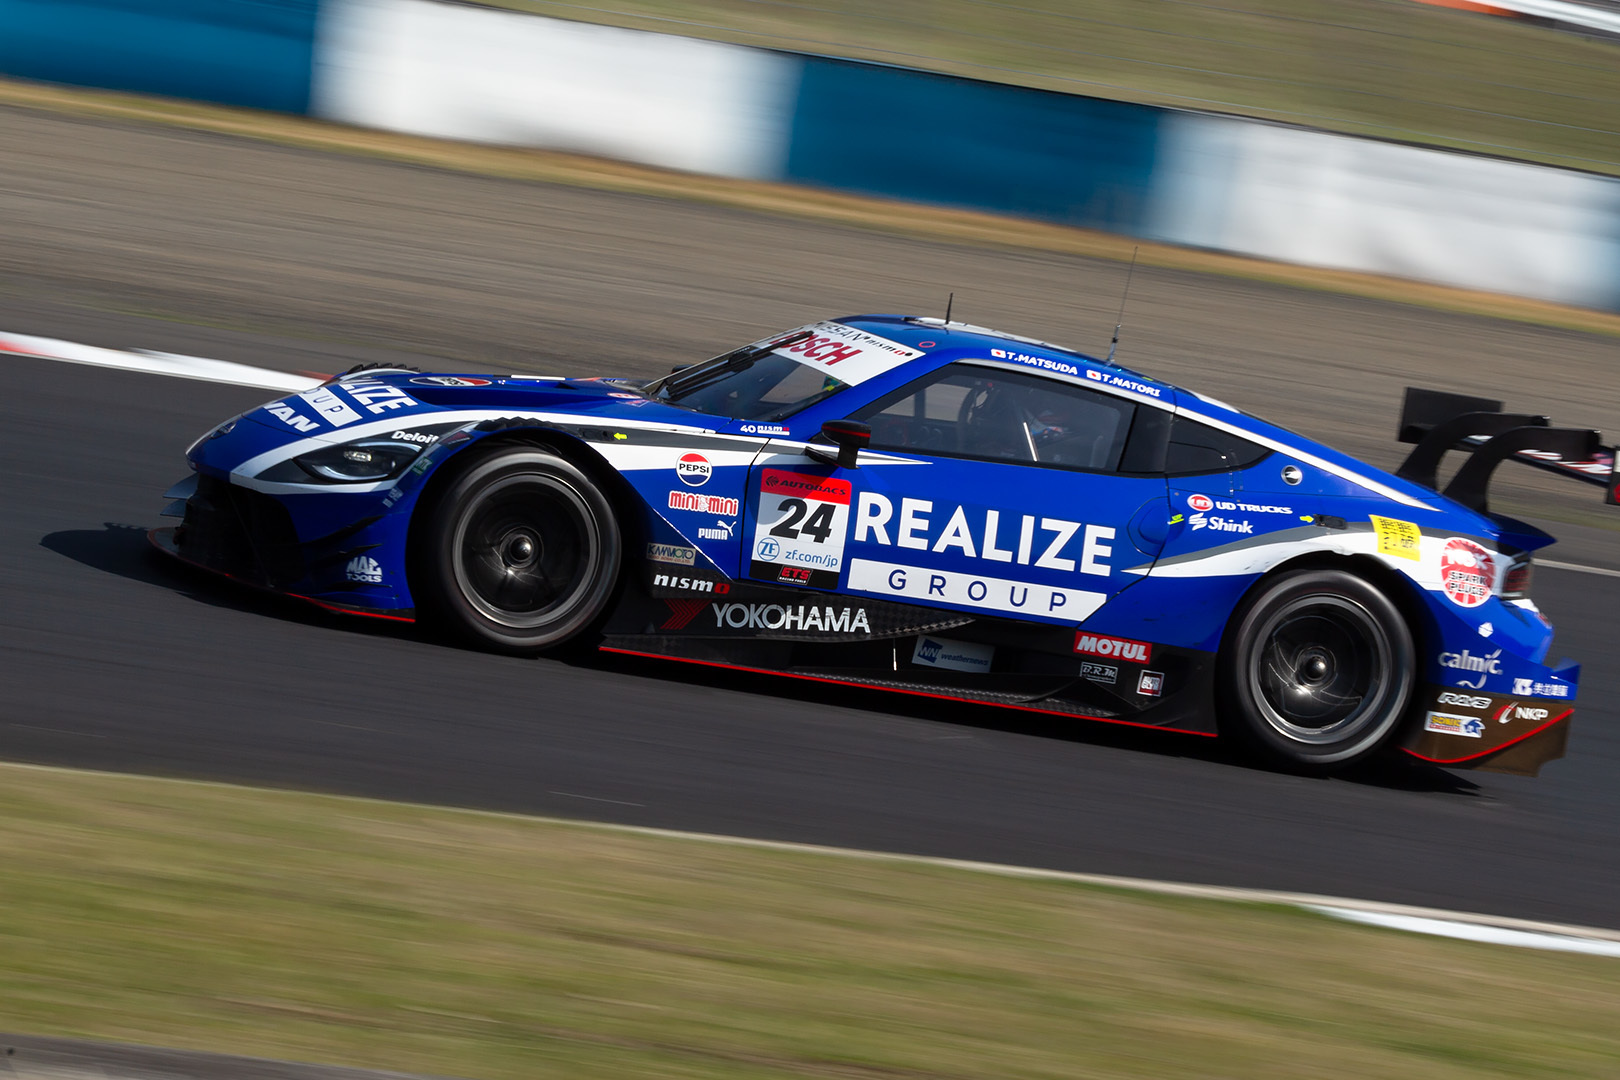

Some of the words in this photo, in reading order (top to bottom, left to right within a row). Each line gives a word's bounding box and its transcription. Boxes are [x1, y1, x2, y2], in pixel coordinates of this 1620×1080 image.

[1006, 351, 1078, 375] T.MATSUDA
[1102, 373, 1161, 397] T.NATORI
[679, 463, 710, 474] PEPSI
[780, 480, 847, 496] AUTOBACS
[1215, 501, 1237, 511] UD
[1236, 503, 1294, 514] TRUCKS
[769, 498, 837, 543] 24
[1208, 516, 1254, 534] Shink
[698, 527, 728, 540] PUMA
[854, 491, 1116, 577] REALIZE
[759, 541, 778, 559] ZF
[784, 549, 839, 568] zf.com/jp
[346, 573, 382, 583] TOOLS
[781, 567, 811, 580] ETS
[1449, 571, 1487, 586] SPARK
[653, 574, 731, 595] nismo
[888, 569, 1067, 612] GROUP
[1449, 582, 1486, 597] PLUGS
[712, 602, 871, 634] YOKOHAMA
[1076, 635, 1148, 661] MOTUL
[1515, 707, 1549, 721] NKP
